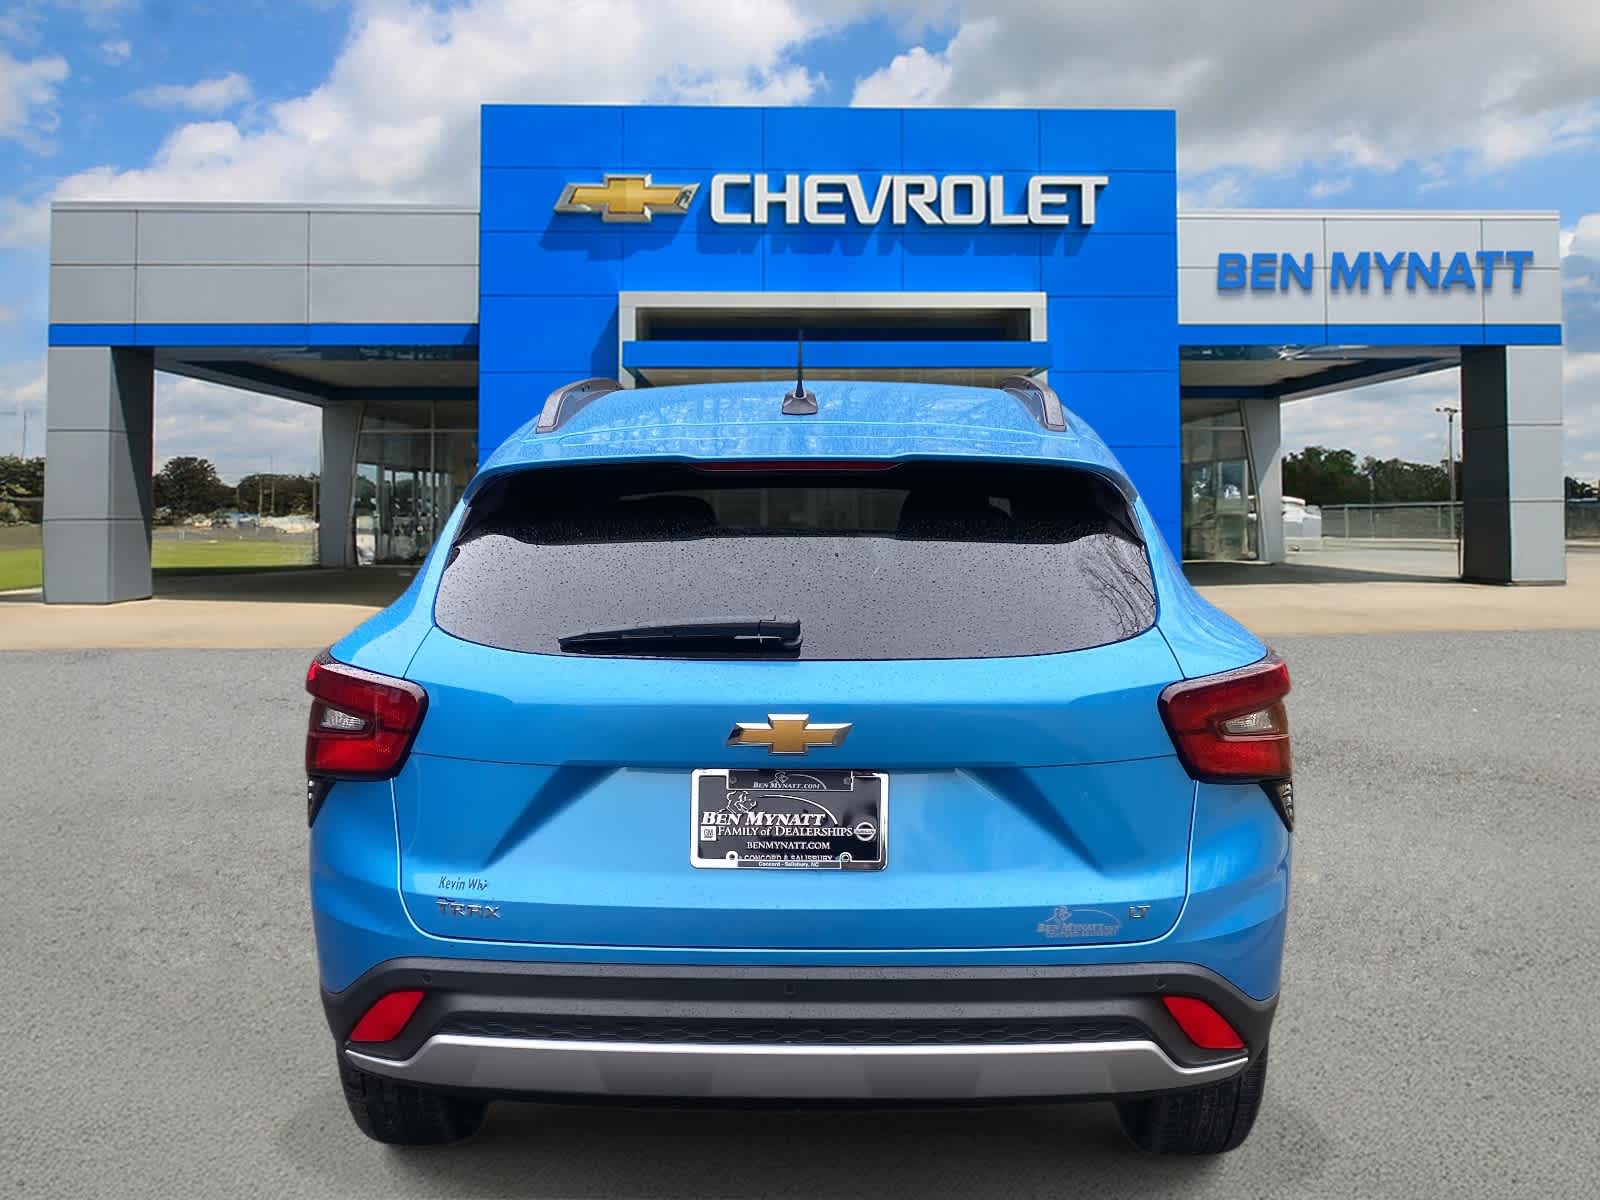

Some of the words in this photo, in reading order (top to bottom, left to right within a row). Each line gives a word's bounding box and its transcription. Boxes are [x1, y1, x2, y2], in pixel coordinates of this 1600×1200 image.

[709, 173, 1109, 225] CHEVROLET
[1217, 252, 1313, 290] BEN
[1330, 250, 1534, 290] MYNATT
[701, 811, 741, 826] BEN
[745, 811, 827, 826] MYNATT
[718, 825, 759, 836] FAMILY
[760, 826, 772, 836] of
[775, 825, 853, 837] DEALERSHIPS
[747, 841, 831, 850] BENMYNATT.COM
[438, 875, 466, 891] Kevin
[435, 901, 501, 919] TRAX
[1128, 904, 1152, 920] LT
